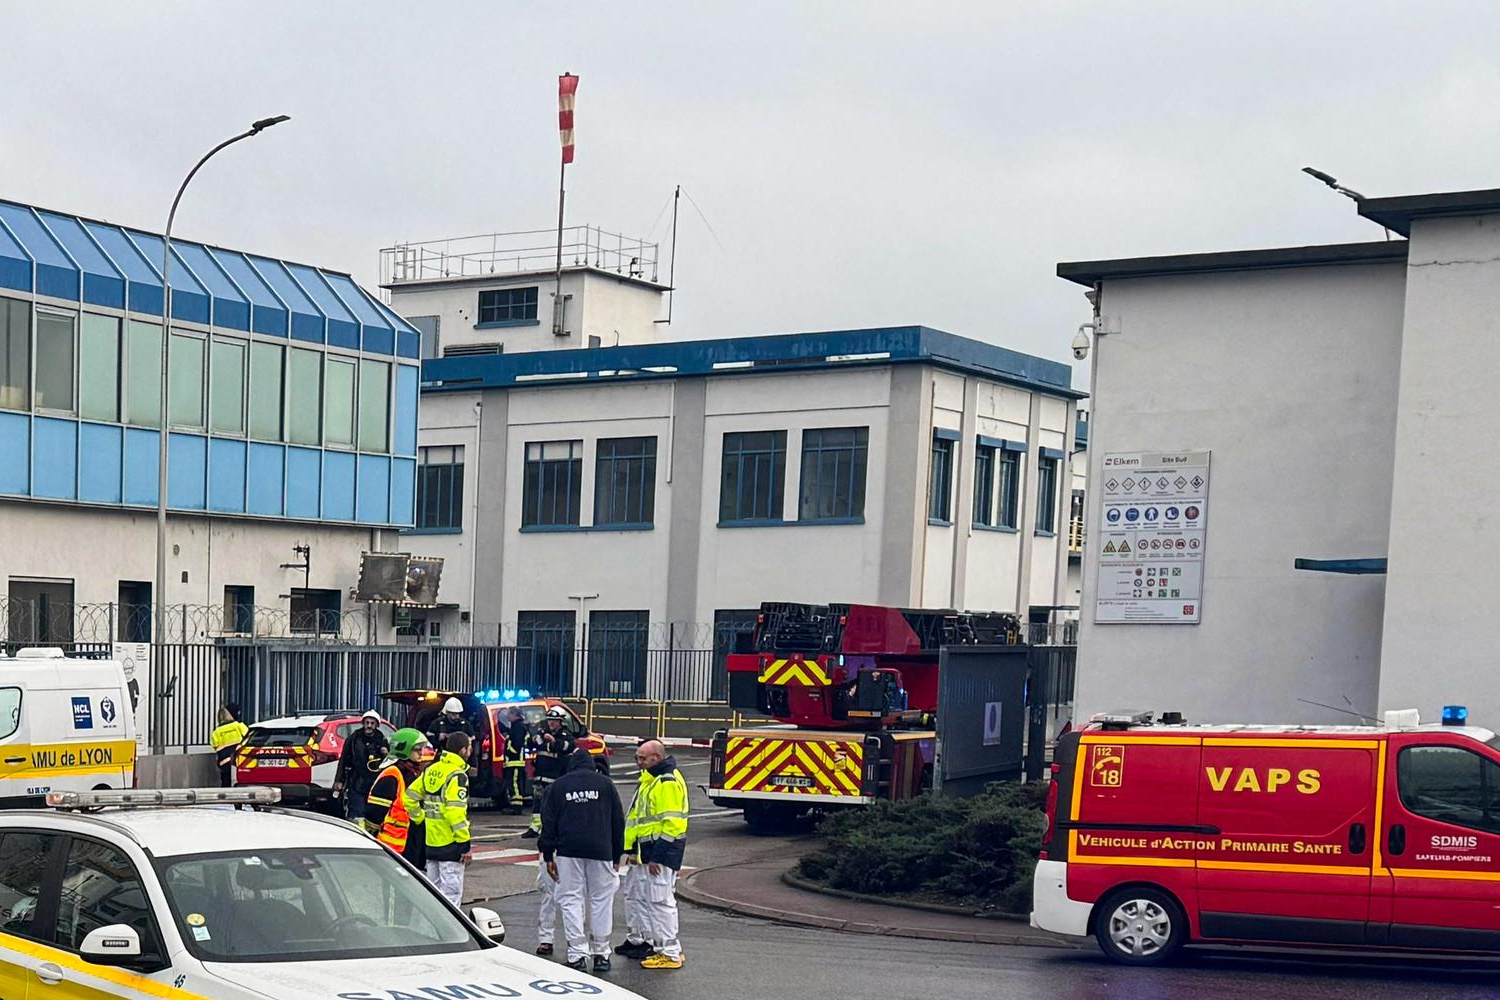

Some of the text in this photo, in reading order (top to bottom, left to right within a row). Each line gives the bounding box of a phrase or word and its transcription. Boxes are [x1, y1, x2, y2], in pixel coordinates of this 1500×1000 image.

[60, 751, 75, 765] de
[79, 748, 112, 765] LYON
[1096, 747, 1112, 756] 112
[1100, 770, 1119, 785] 18
[1205, 767, 1321, 794] VAPS
[1079, 834, 1147, 848] VEHICULE
[1220, 839, 1289, 853] PRIMAIRE
[1293, 841, 1342, 855] SANTE
[1431, 835, 1478, 847] SDMIS
[528, 979, 603, 995] 69
